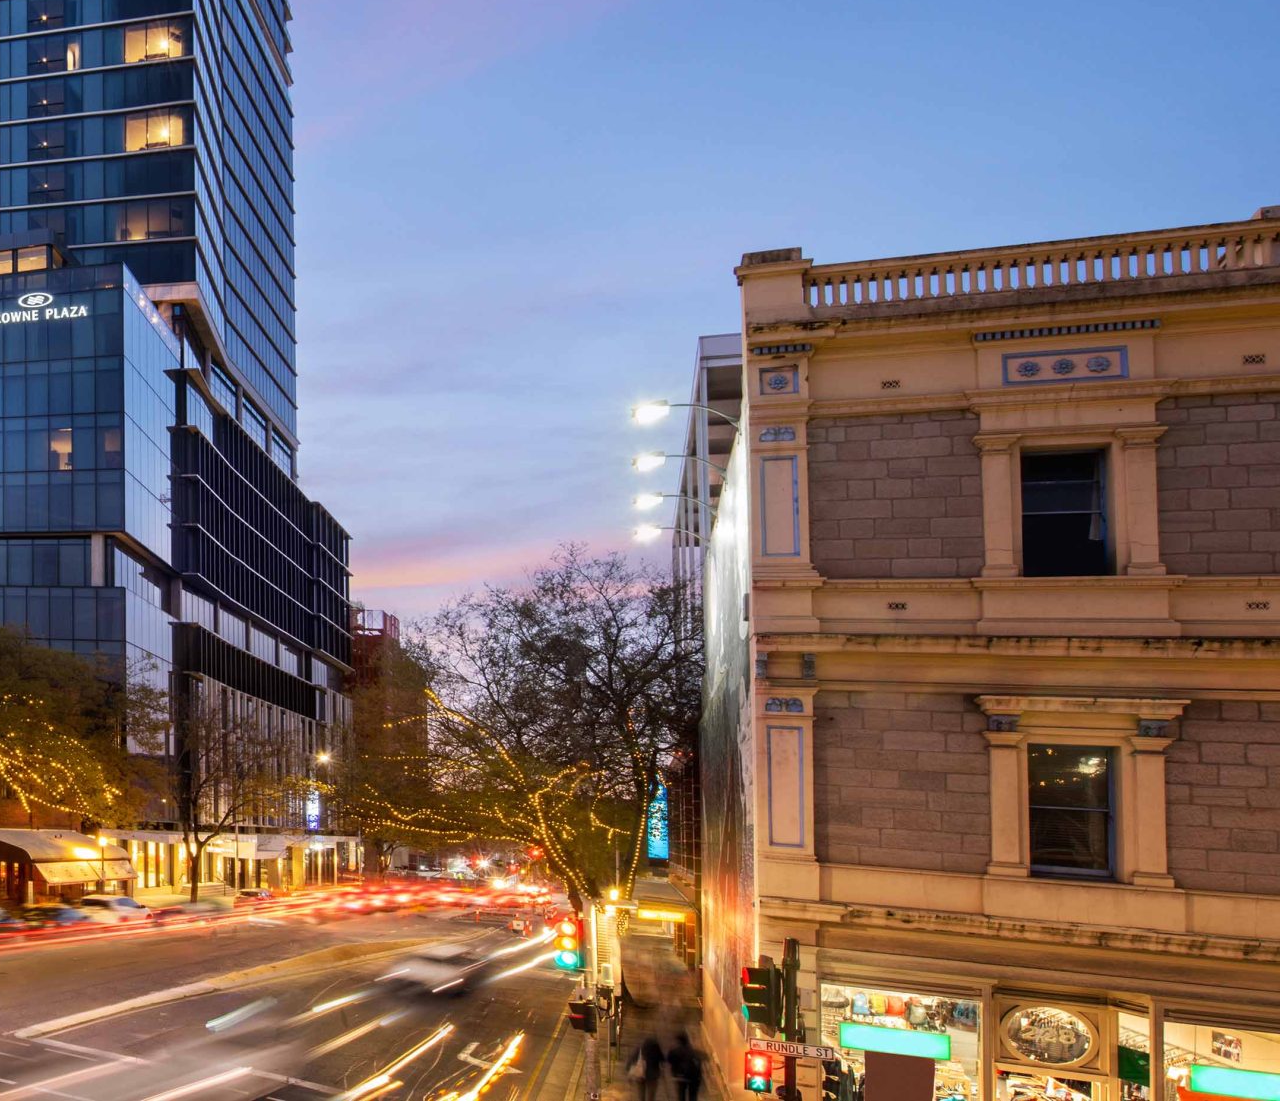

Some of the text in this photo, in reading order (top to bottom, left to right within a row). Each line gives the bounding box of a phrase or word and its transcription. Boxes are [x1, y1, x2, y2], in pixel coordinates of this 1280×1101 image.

[45, 306, 87, 320] PLAZA
[766, 1042, 809, 1055] RUNDLE
[816, 1048, 829, 1058] ST
